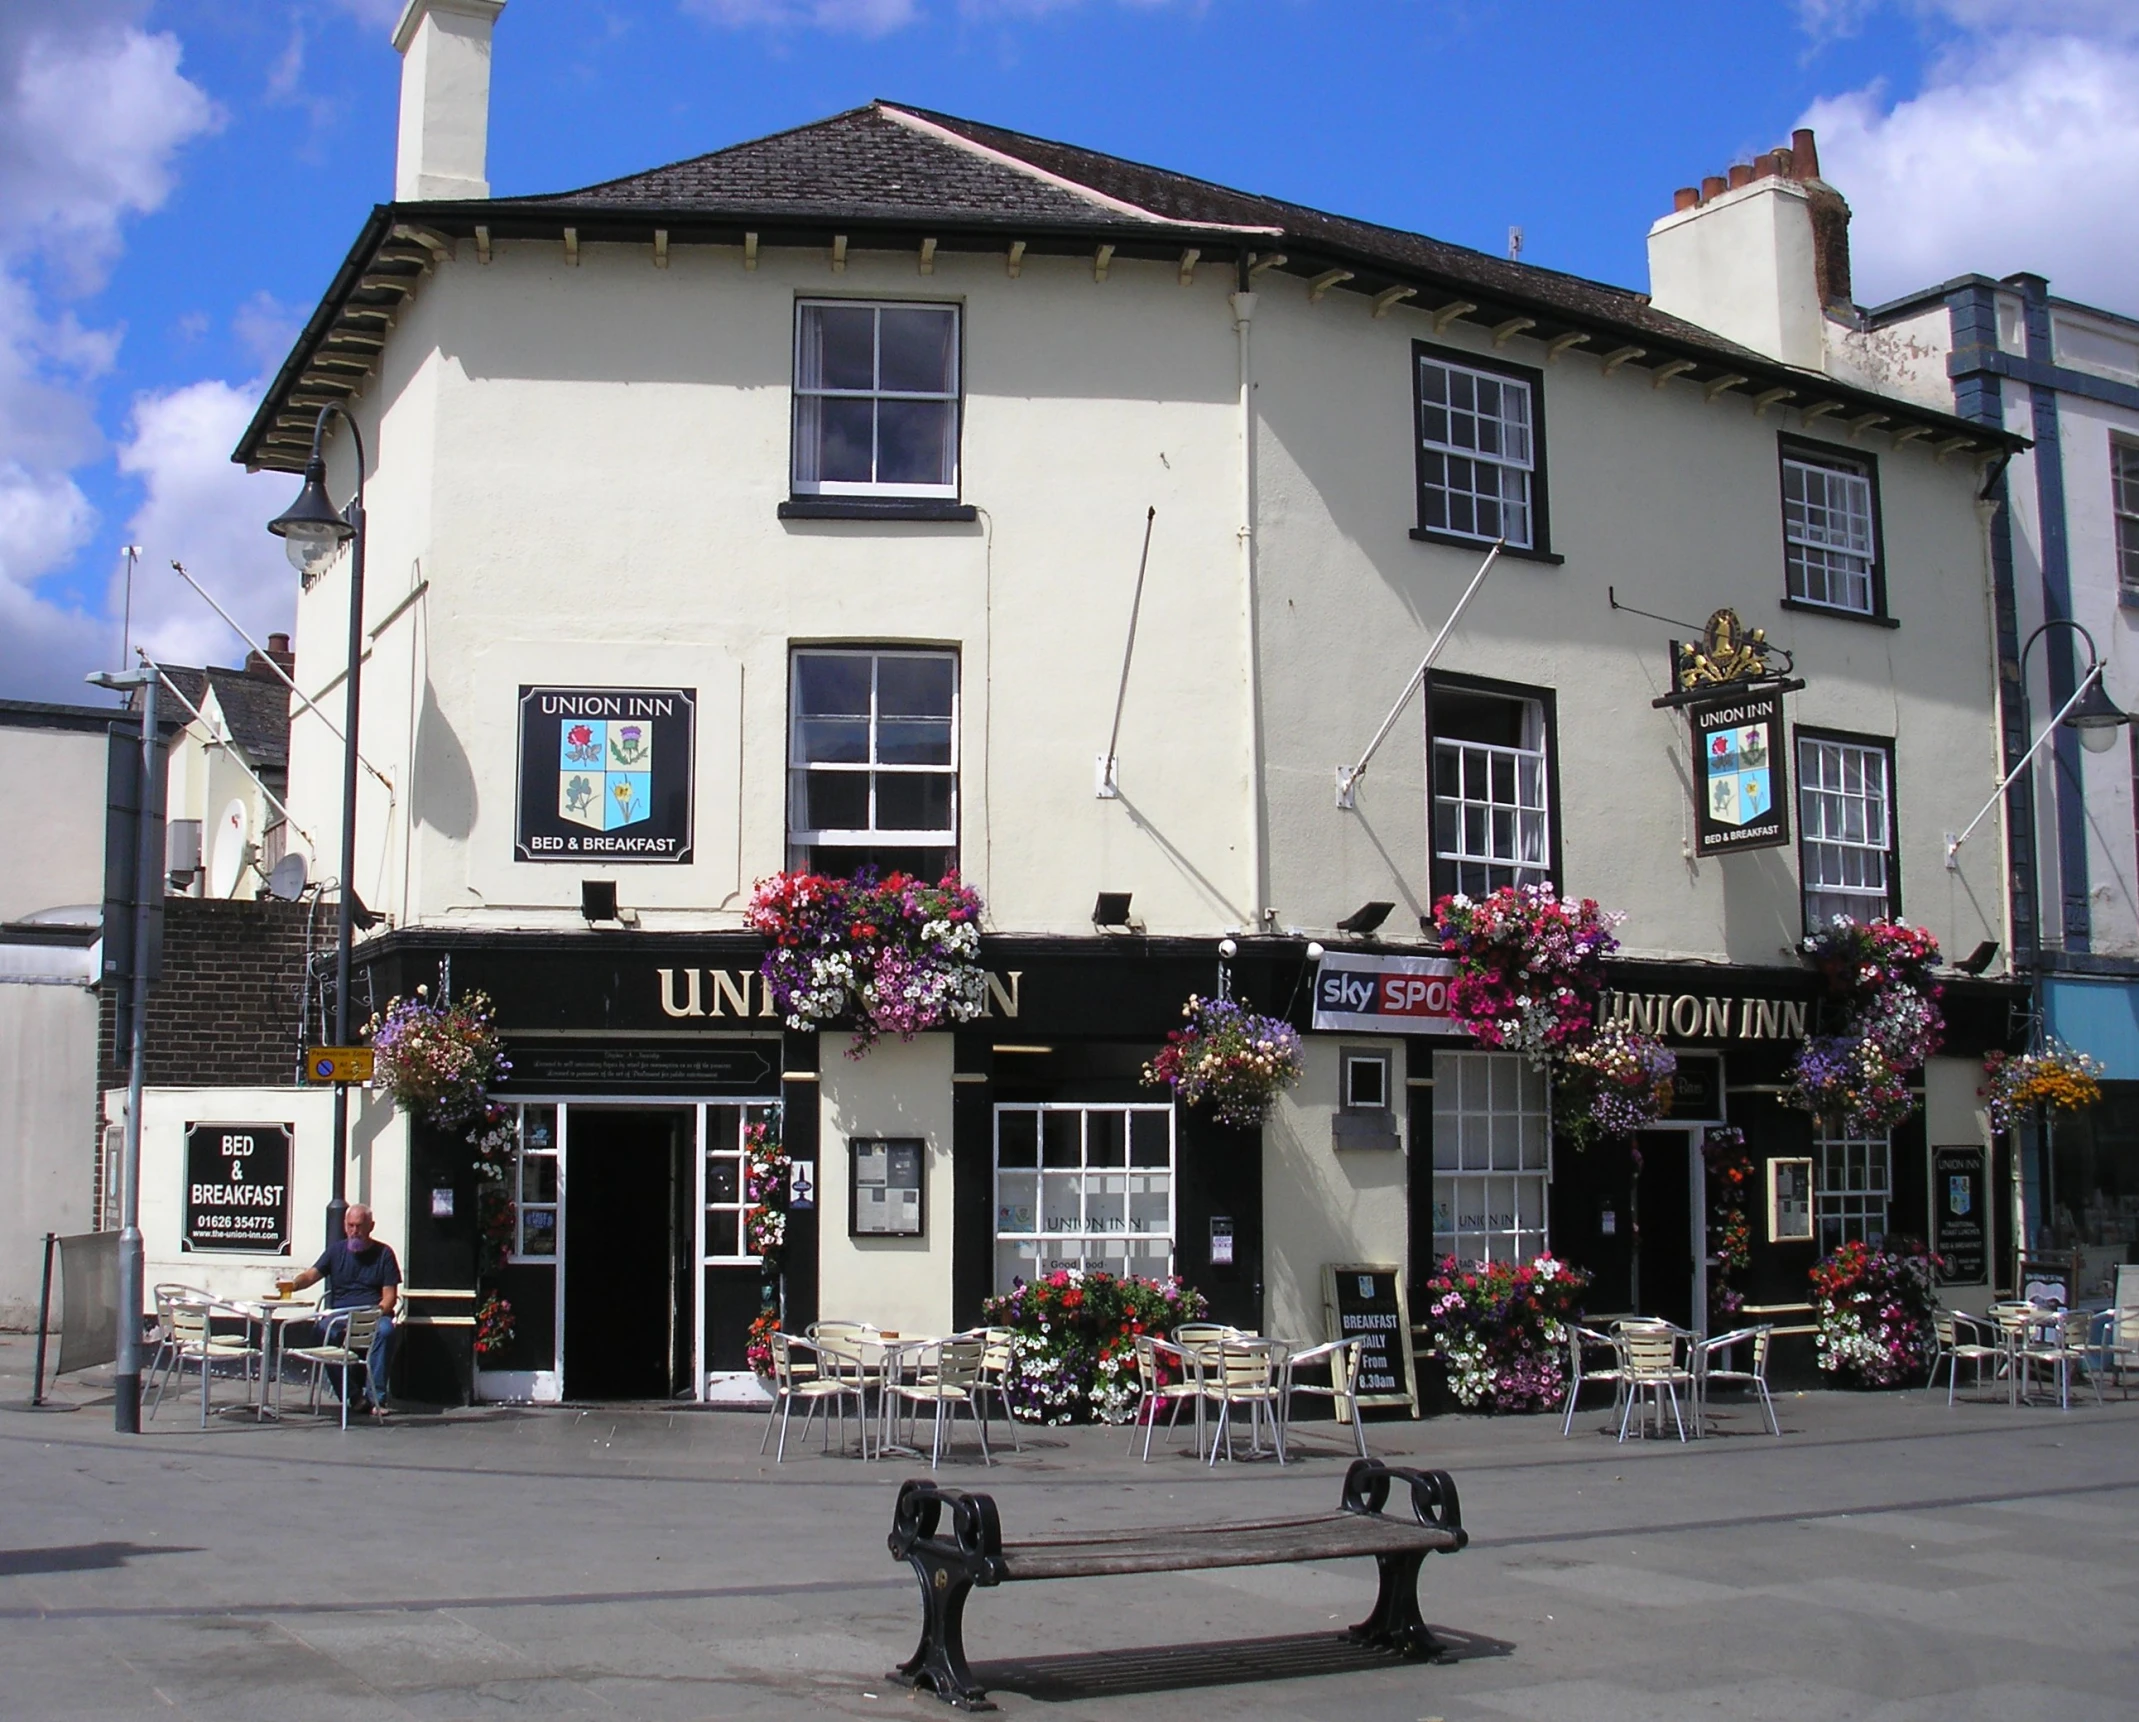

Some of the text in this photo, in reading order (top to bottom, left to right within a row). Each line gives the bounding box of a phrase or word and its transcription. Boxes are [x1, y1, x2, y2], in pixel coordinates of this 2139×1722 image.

[542, 696, 673, 717] UNION INN
[1700, 701, 1773, 728] UNION INN
[532, 836, 676, 852] BED & BREAKFAST
[1704, 825, 1779, 845] BED & BREAKFAST
[656, 968, 779, 1018] UNI
[1324, 973, 1452, 1012] sky SPO
[1739, 998, 1807, 1039] INN
[222, 1135, 254, 1156] BED
[231, 1160, 243, 1180] &
[1938, 1159, 1981, 1170] UNION INN
[192, 1184, 284, 1206] BREAKFAST
[198, 1215, 275, 1229] 01626 354775
[1047, 1216, 1103, 1231] UNION
[192, 1230, 279, 1240] www.the-union-inn.com
[1050, 1259, 1077, 1270] Good
[1343, 1315, 1397, 1329] BREAKFAST
[1362, 1354, 1388, 1369] From
[1358, 1374, 1396, 1389] 8.30am
